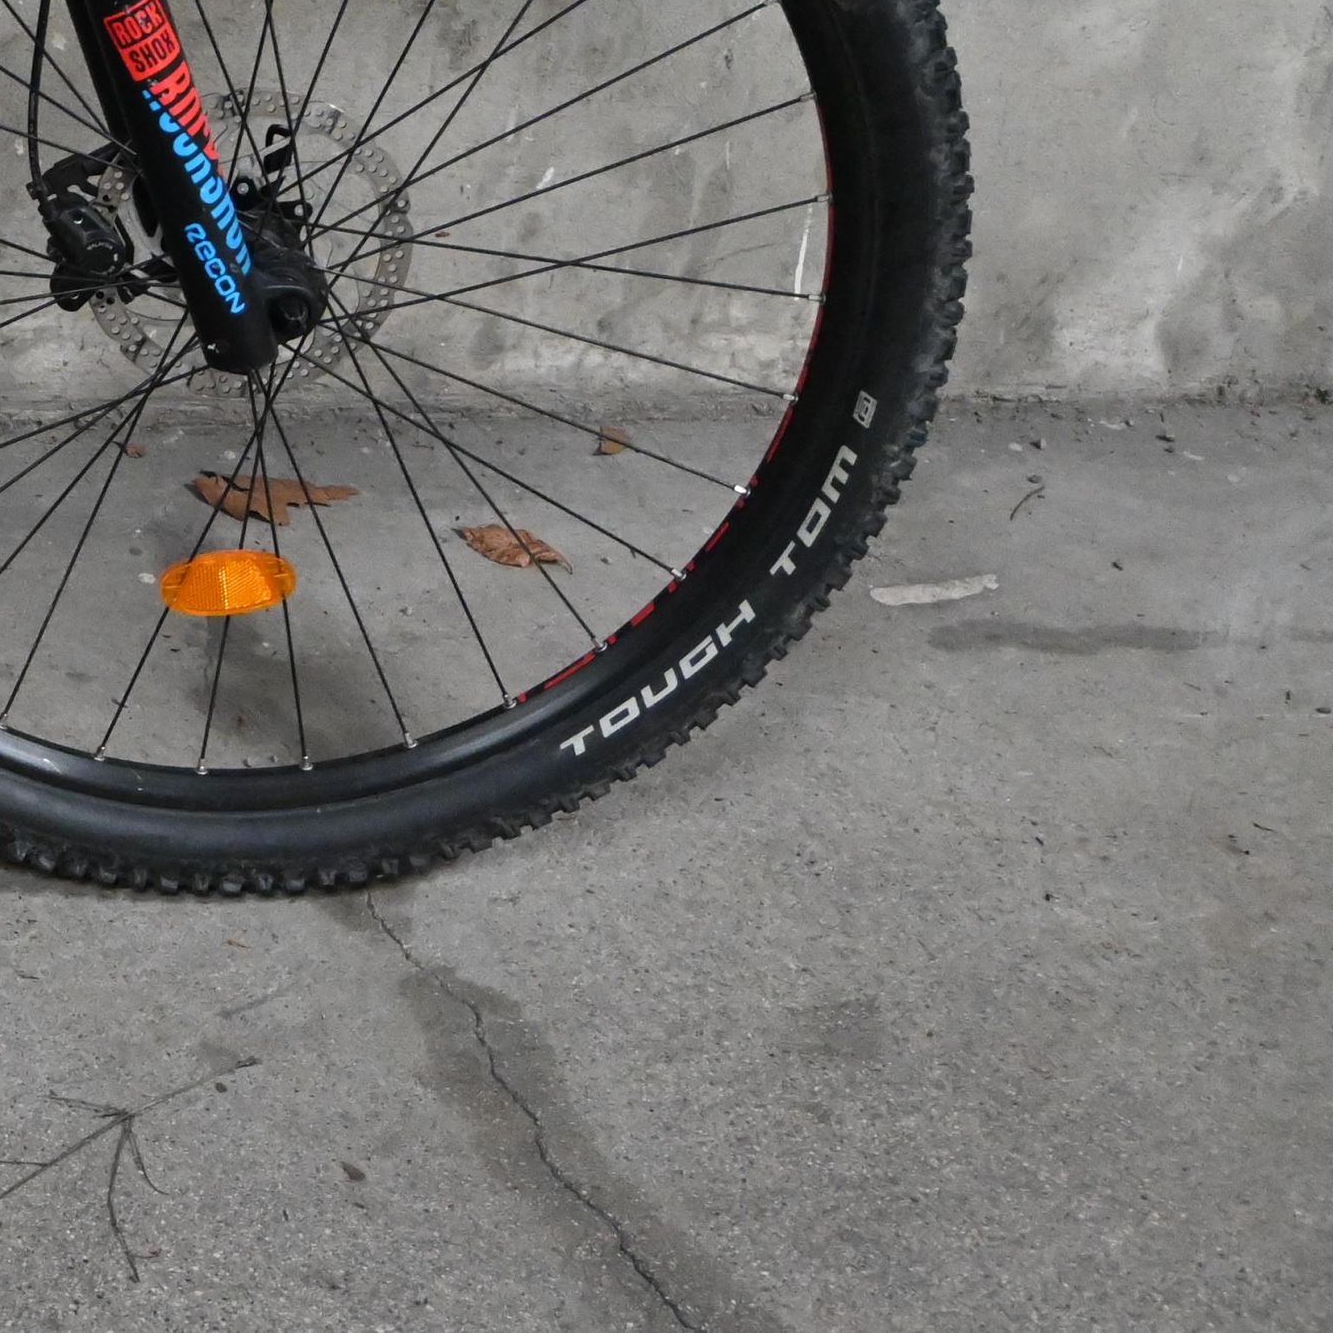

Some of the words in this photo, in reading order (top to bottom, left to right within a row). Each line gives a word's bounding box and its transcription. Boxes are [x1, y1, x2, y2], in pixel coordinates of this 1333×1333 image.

[112, 3, 162, 42] ROCK
[130, 30, 175, 73] SHOX
[185, 222, 246, 314] RECON
[560, 599, 757, 756] TOUGH
[769, 445, 858, 576] TOM
